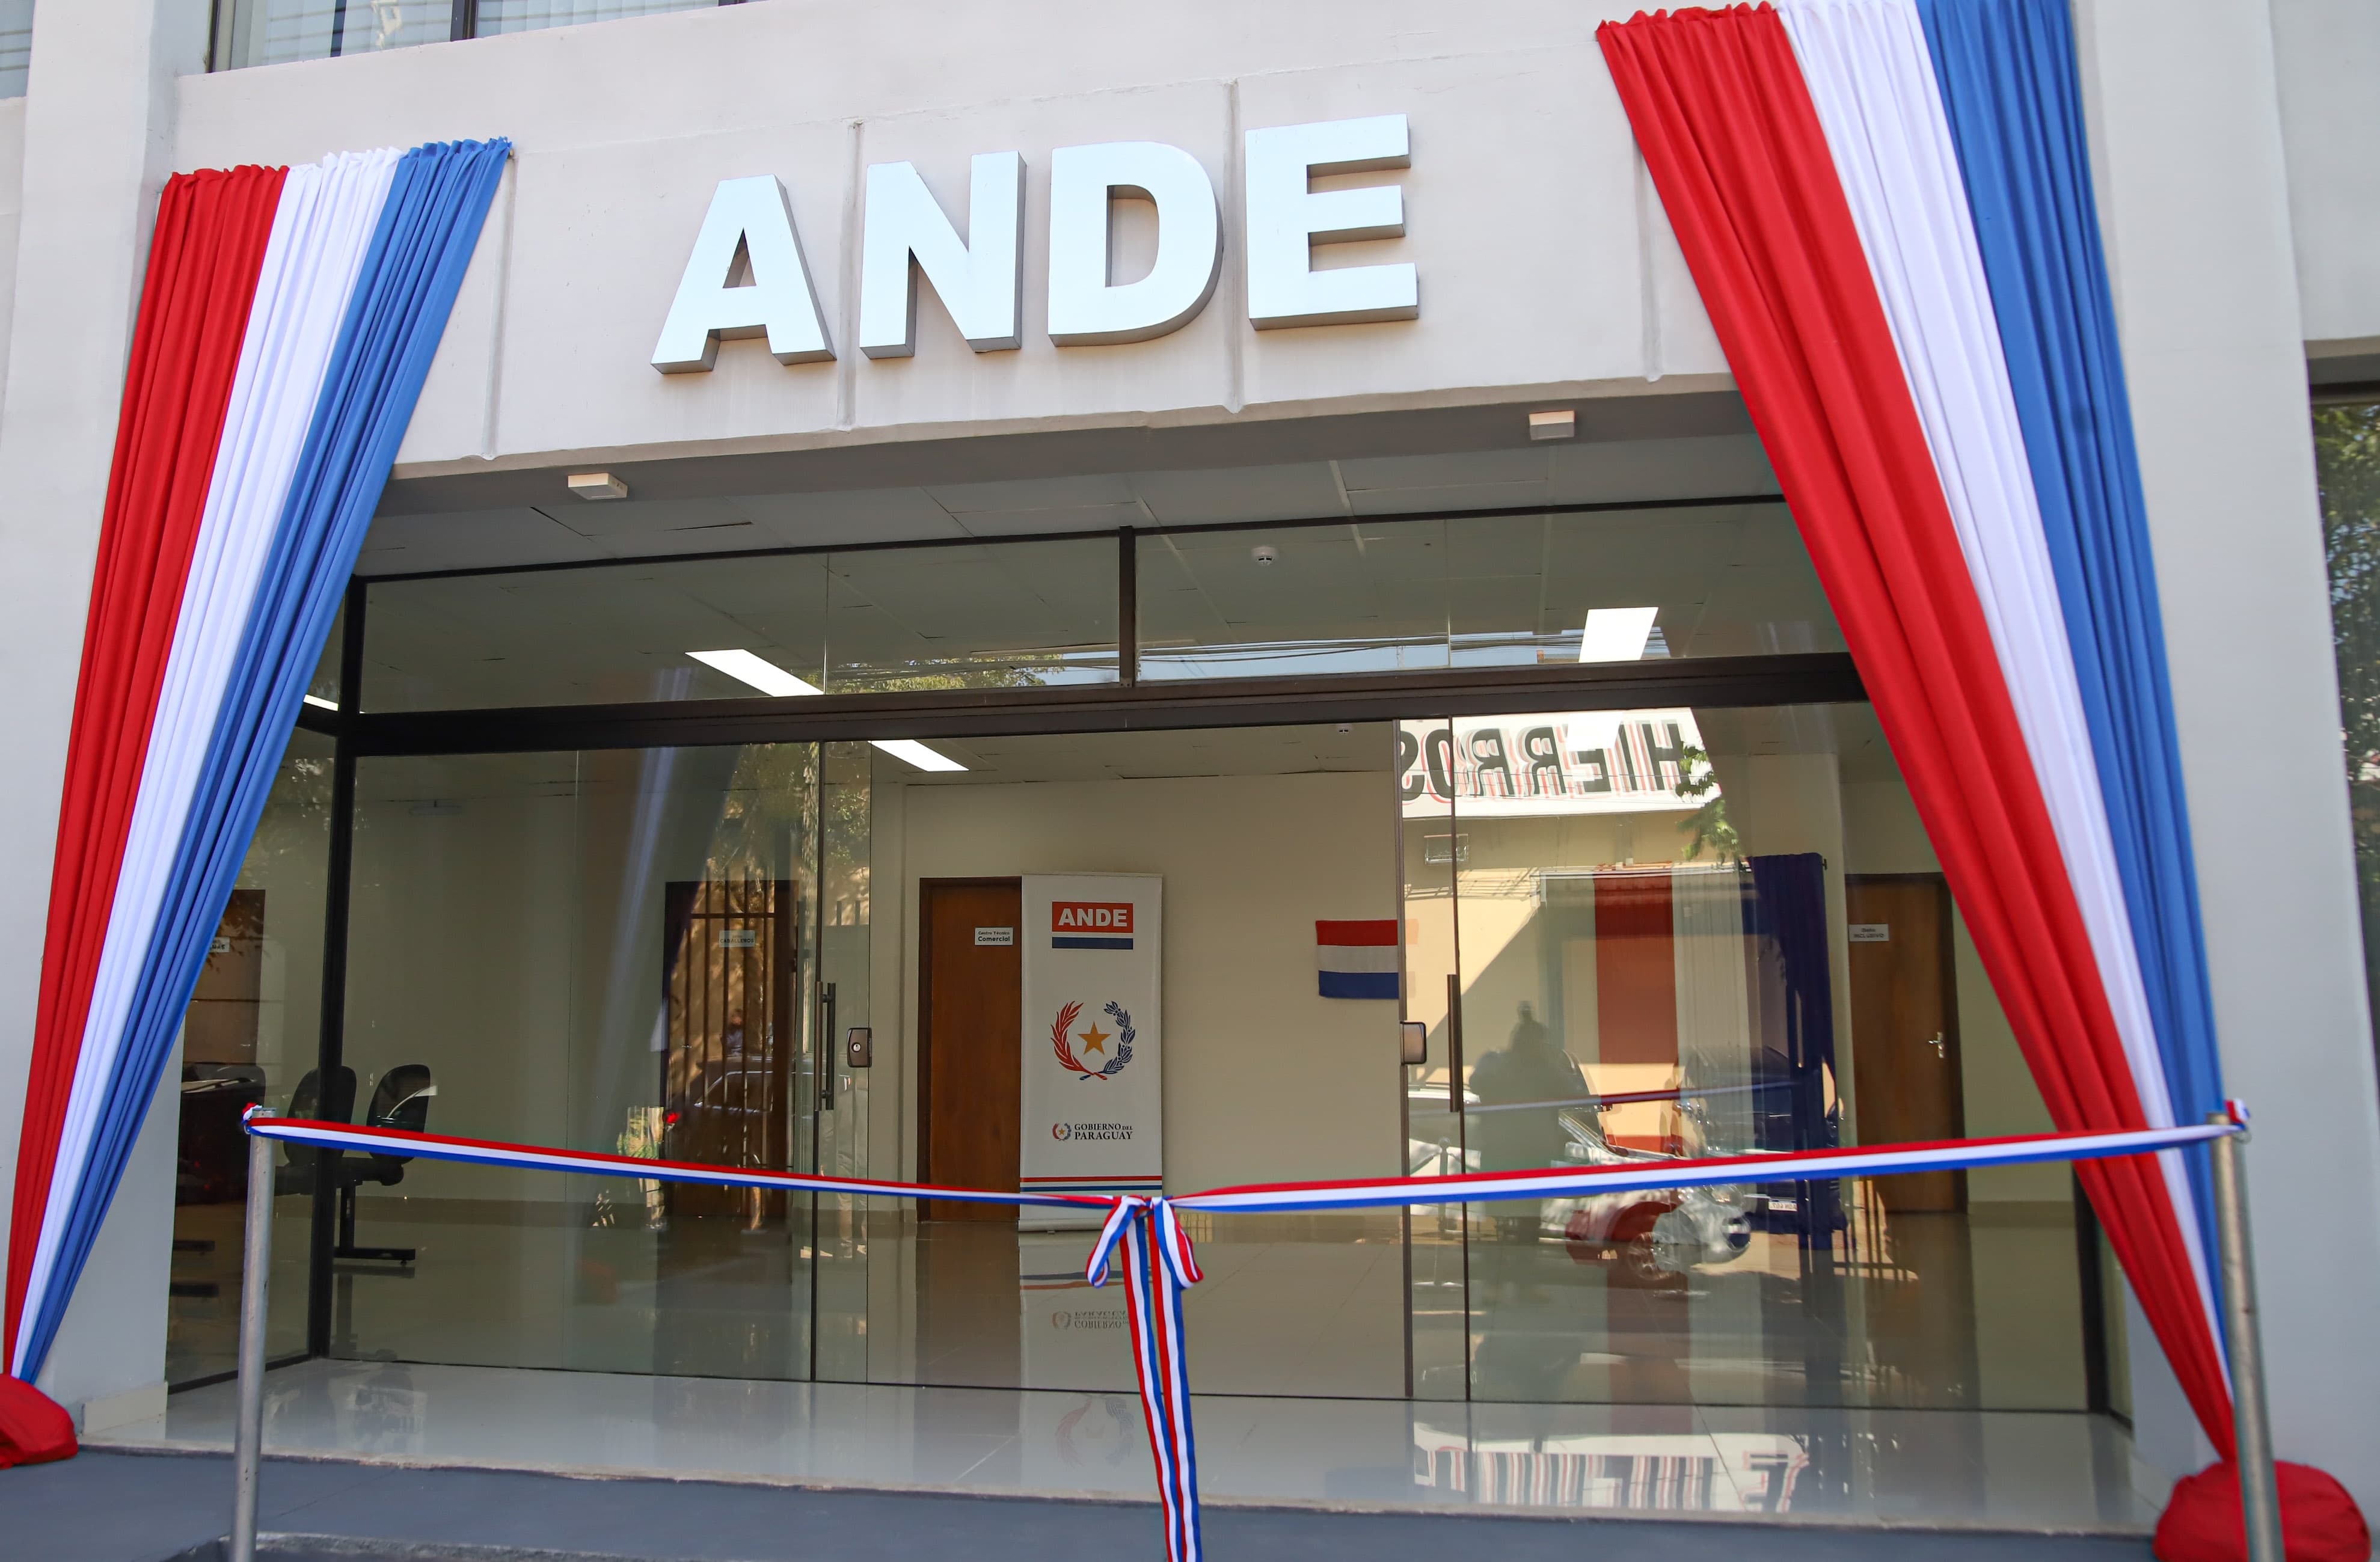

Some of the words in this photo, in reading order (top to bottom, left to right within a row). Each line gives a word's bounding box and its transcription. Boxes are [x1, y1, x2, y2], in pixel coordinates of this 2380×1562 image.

[651, 113, 1419, 373] ANDE
[1058, 908, 1127, 927] ANDE
[1074, 1131, 1133, 1141] PARAGUAY
